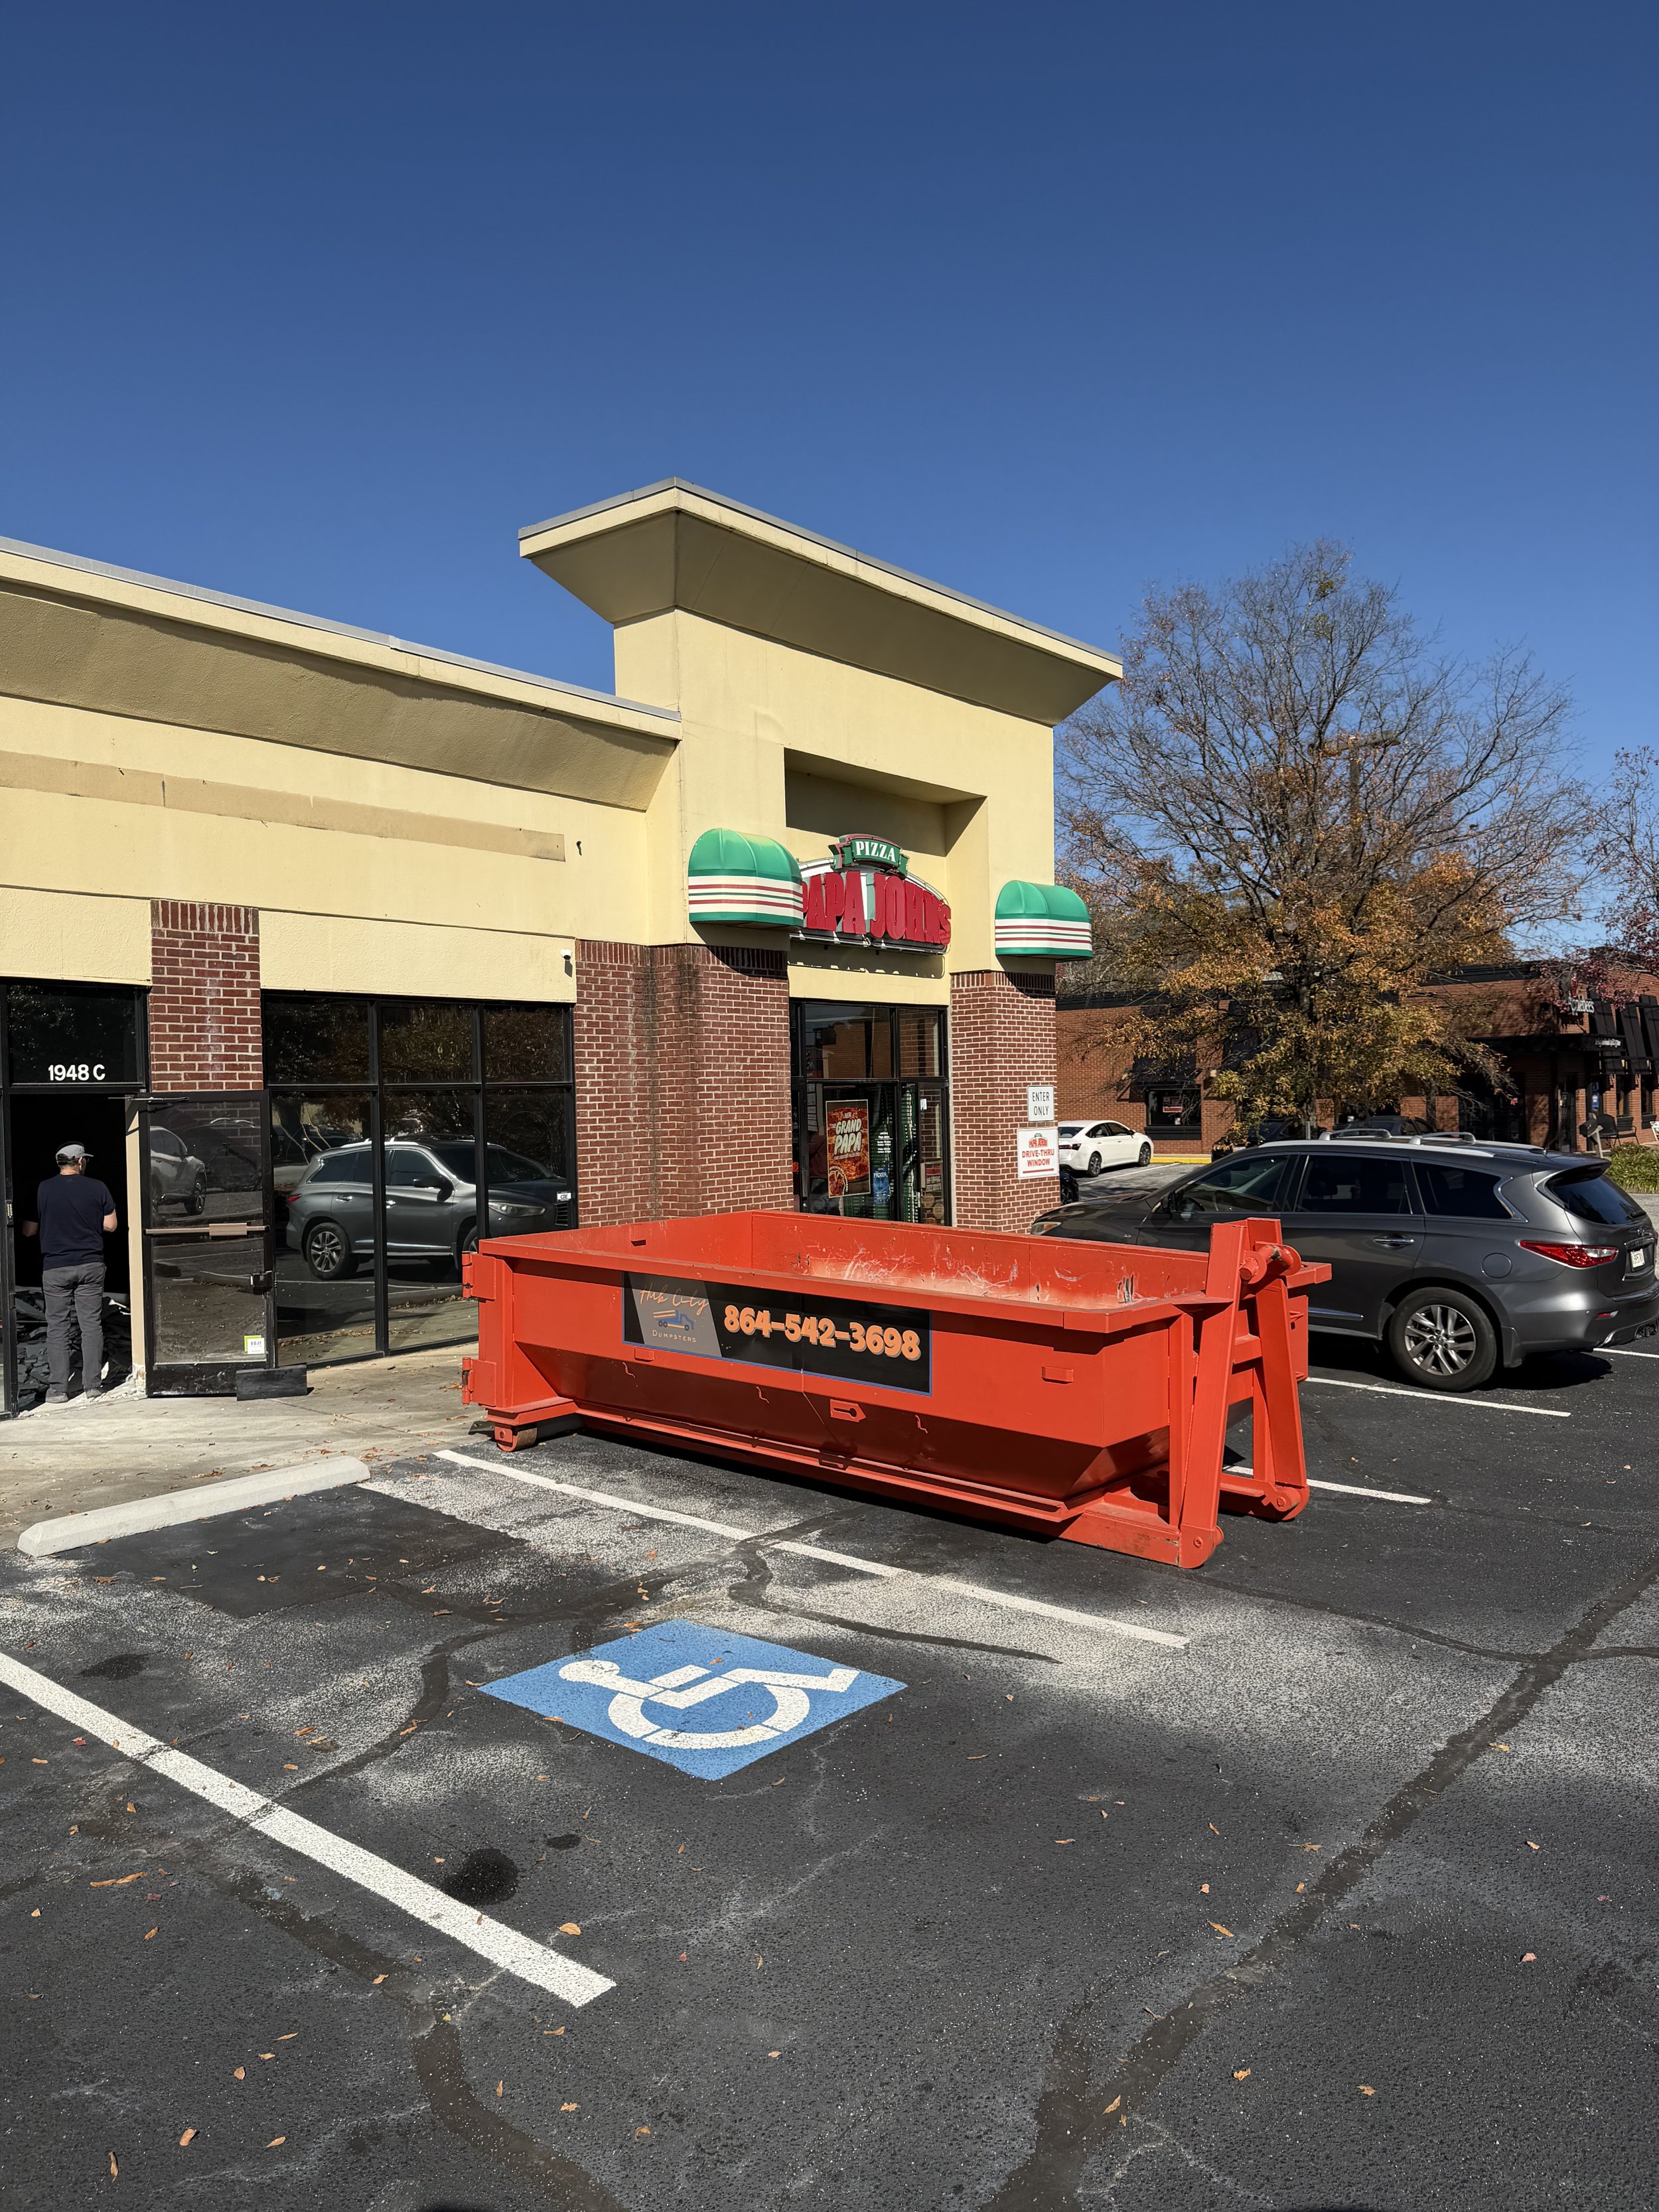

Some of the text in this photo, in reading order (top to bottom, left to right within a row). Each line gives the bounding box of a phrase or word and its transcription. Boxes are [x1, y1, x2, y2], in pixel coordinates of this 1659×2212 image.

[855, 841, 897, 863] PIZZA
[48, 1064, 106, 1081] 1948 C
[1032, 1092, 1050, 1102] ENTER
[1033, 1106, 1049, 1116] ONLY
[836, 1118, 862, 1135] GRAND
[834, 1132, 862, 1155] PAPA
[1022, 1149, 1054, 1158] DRIVE-THRU
[1027, 1158, 1050, 1167] WINDOW
[640, 1282, 709, 1316] Hub City
[652, 1329, 697, 1343] DUMPSTERS
[724, 1304, 921, 1361] 864-542-3698
